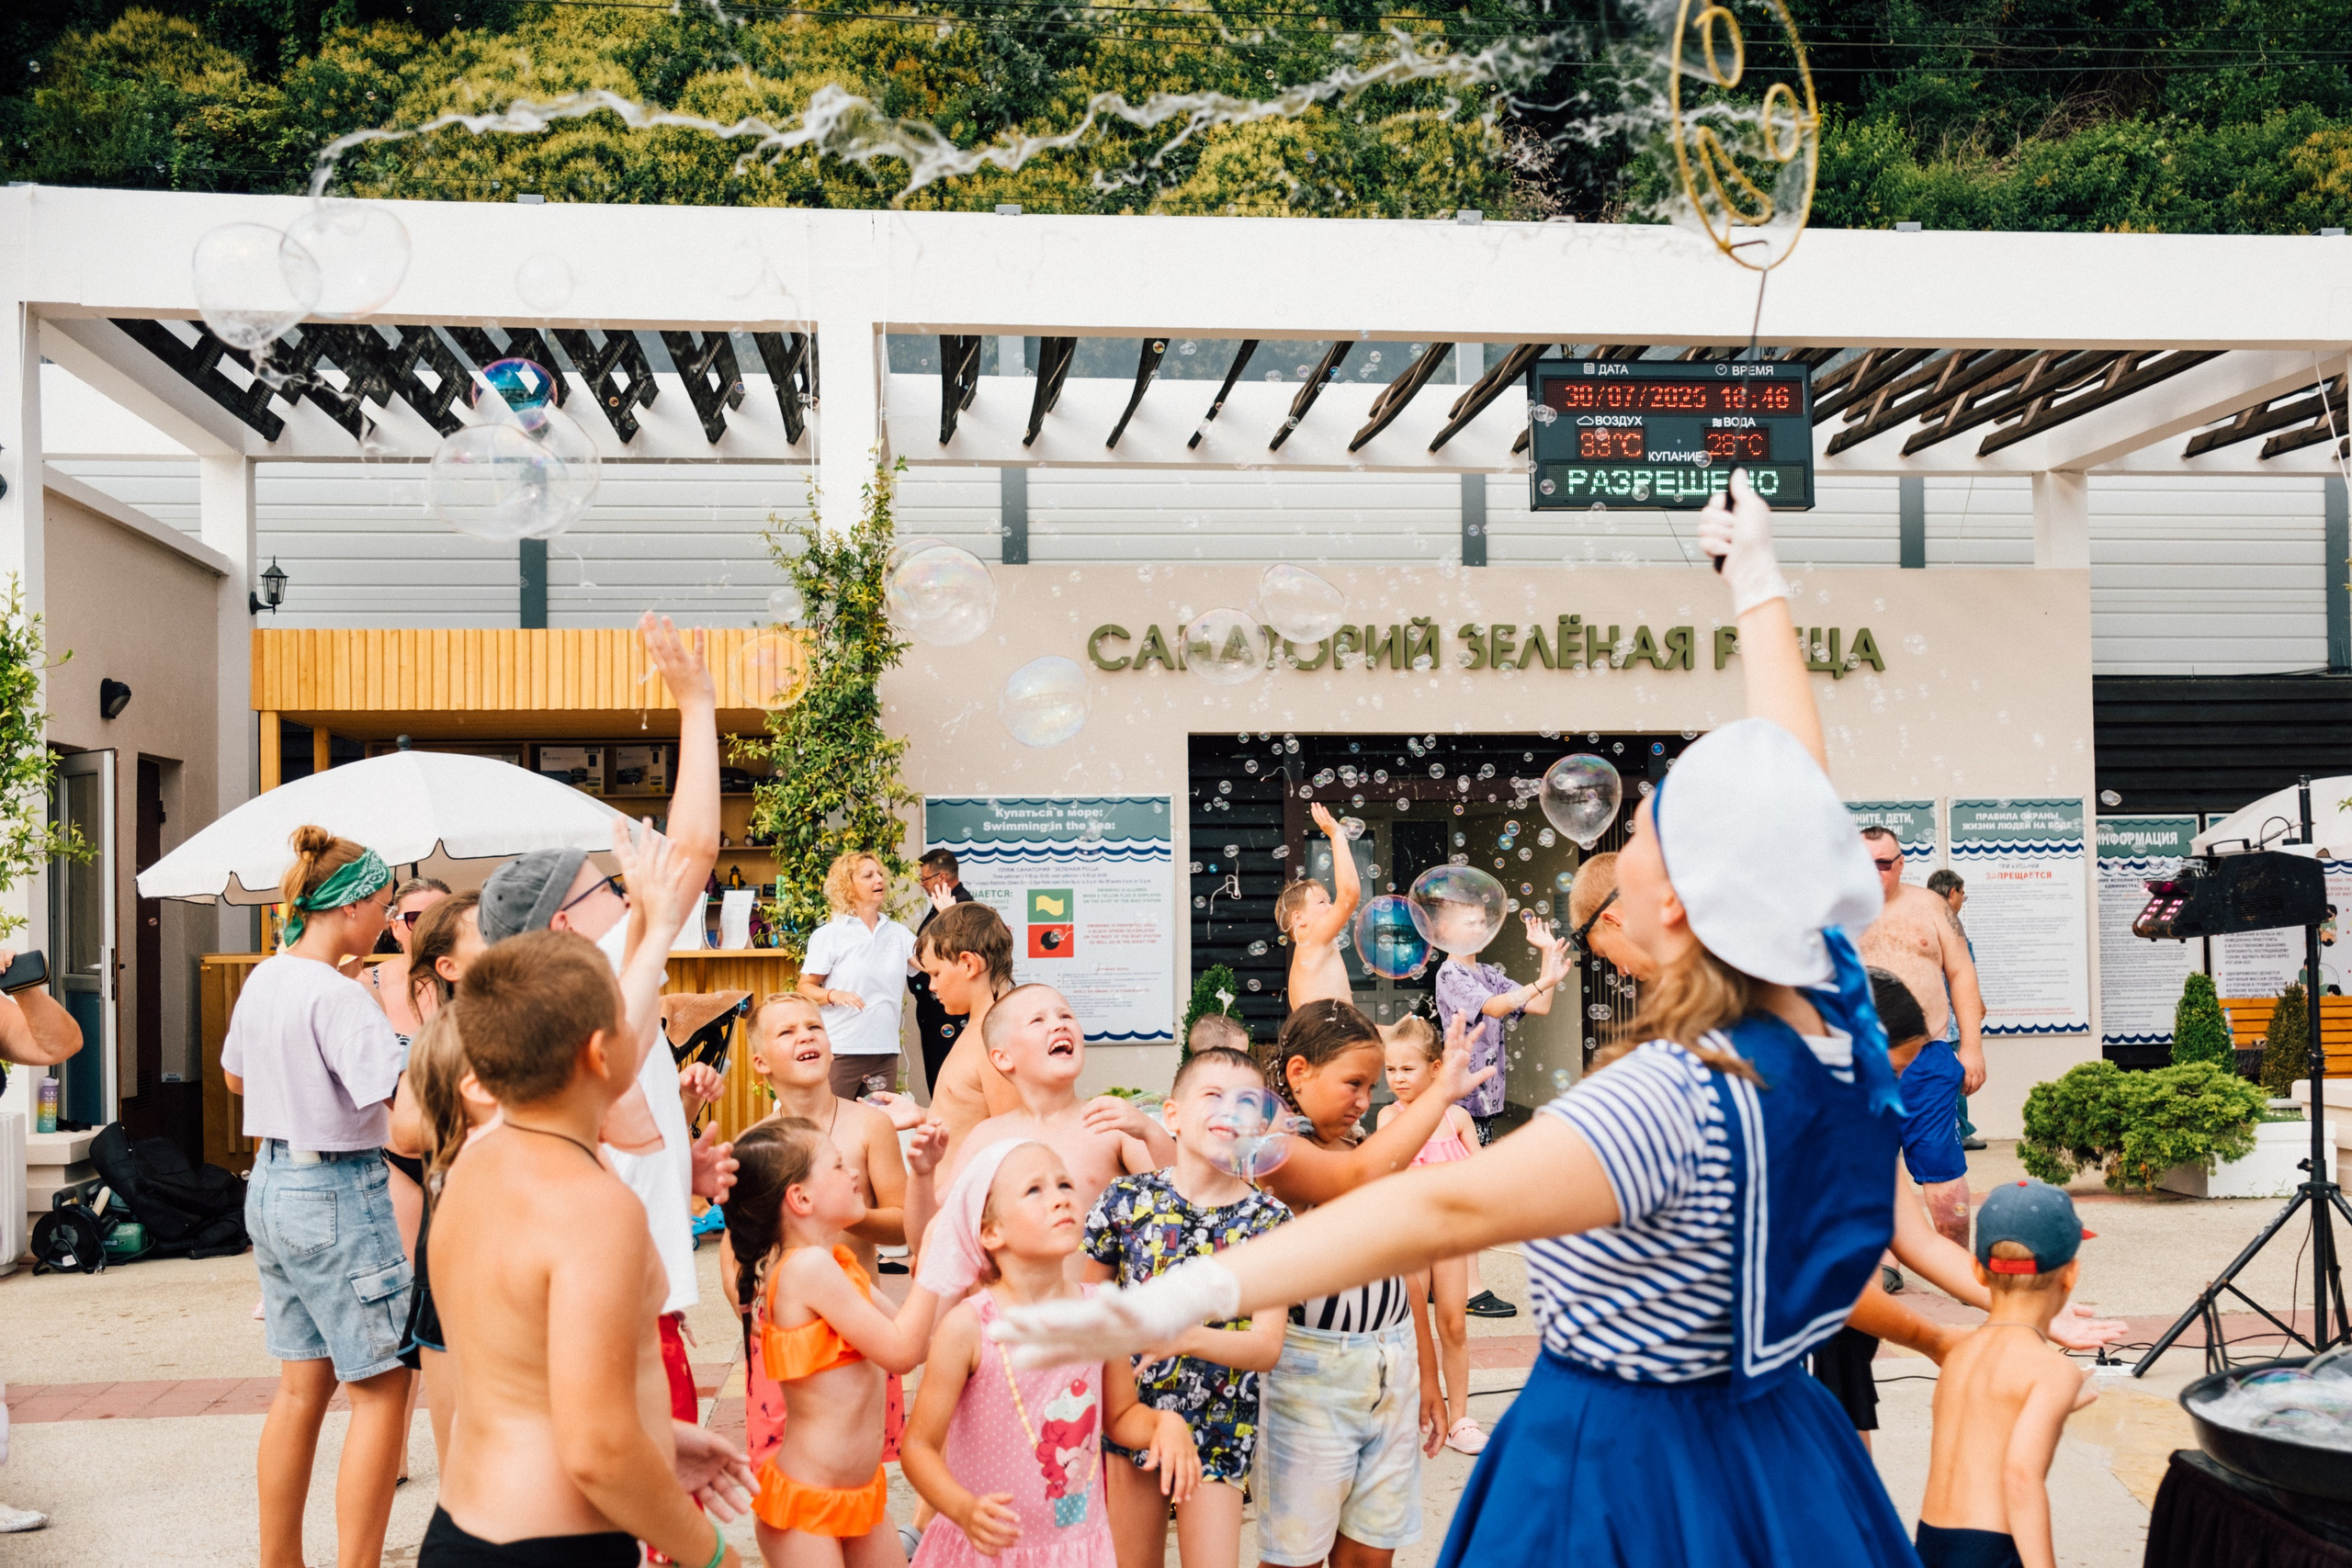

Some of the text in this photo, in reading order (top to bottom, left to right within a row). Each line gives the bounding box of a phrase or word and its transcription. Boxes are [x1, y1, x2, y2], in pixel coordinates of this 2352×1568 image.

[1599, 364, 1629, 376] ДАТА
[1732, 365, 1774, 376] ВРЕМЯ
[1565, 385, 1707, 408] 30/07/2025
[1595, 415, 1643, 427] ВОЗДУХ
[1723, 417, 1757, 428] ВОДА
[1648, 451, 1702, 462] КУПАНИЕ
[1567, 469, 1780, 495] РАЗРЕШЕО
[1457, 614, 1694, 671] ЗЕЛЁНАЯ
[1714, 626, 1886, 680] РЩА
[995, 808, 1053, 819] Купаться
[1068, 808, 1102, 819] море:
[1885, 812, 1914, 825] ДЕТИ,
[1975, 812, 2059, 821] ПРАВИЛА ОХРАНЫ
[983, 821, 1048, 832] Swimming
[1050, 821, 1062, 830] in
[1066, 821, 1086, 830] the
[1962, 821, 2073, 831] ЖИЗНИ ЛЮДЕЙ НА ВОДЕ
[2096, 831, 2178, 847] ИНФОРМАЦИЯ
[1986, 871, 2052, 880] ЗАПРЕЩАЕТСЯ
[969, 889, 1013, 898] ШАЕТСЯ:
